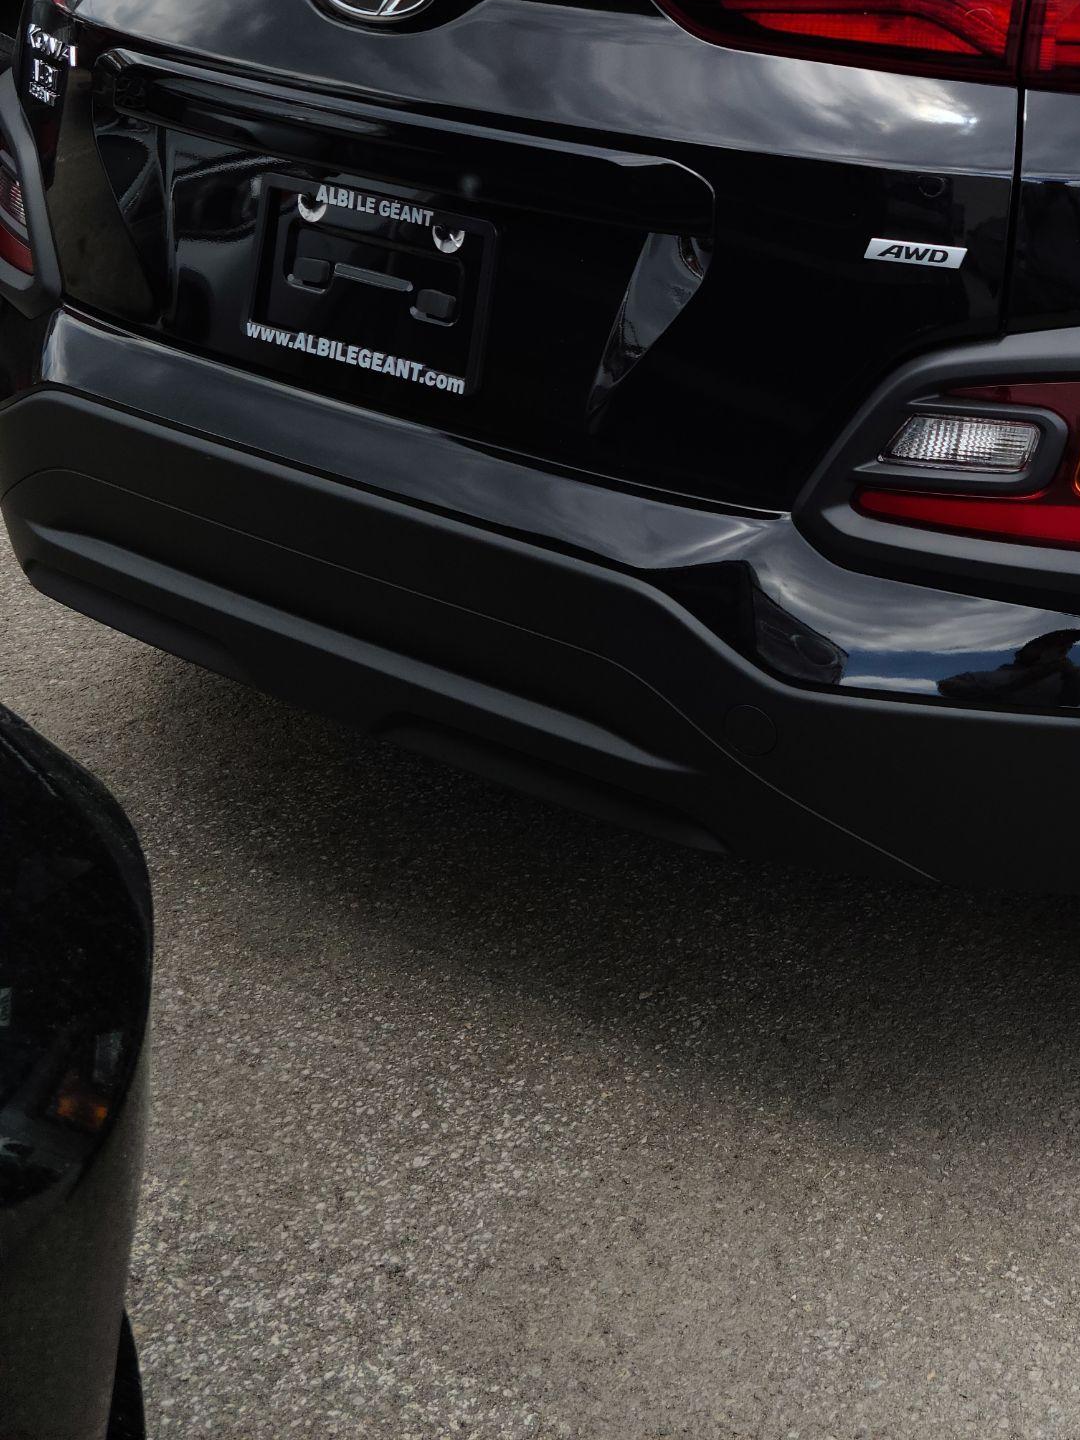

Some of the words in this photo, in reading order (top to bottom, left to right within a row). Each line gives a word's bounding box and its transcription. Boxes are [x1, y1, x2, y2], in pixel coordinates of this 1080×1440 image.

[315, 184, 355, 209] ALBI
[356, 195, 376, 214] LE
[378, 199, 434, 227] GÉANT
[876, 244, 949, 264] AWD
[246, 322, 466, 395] www.ALBILEGEANT.com
